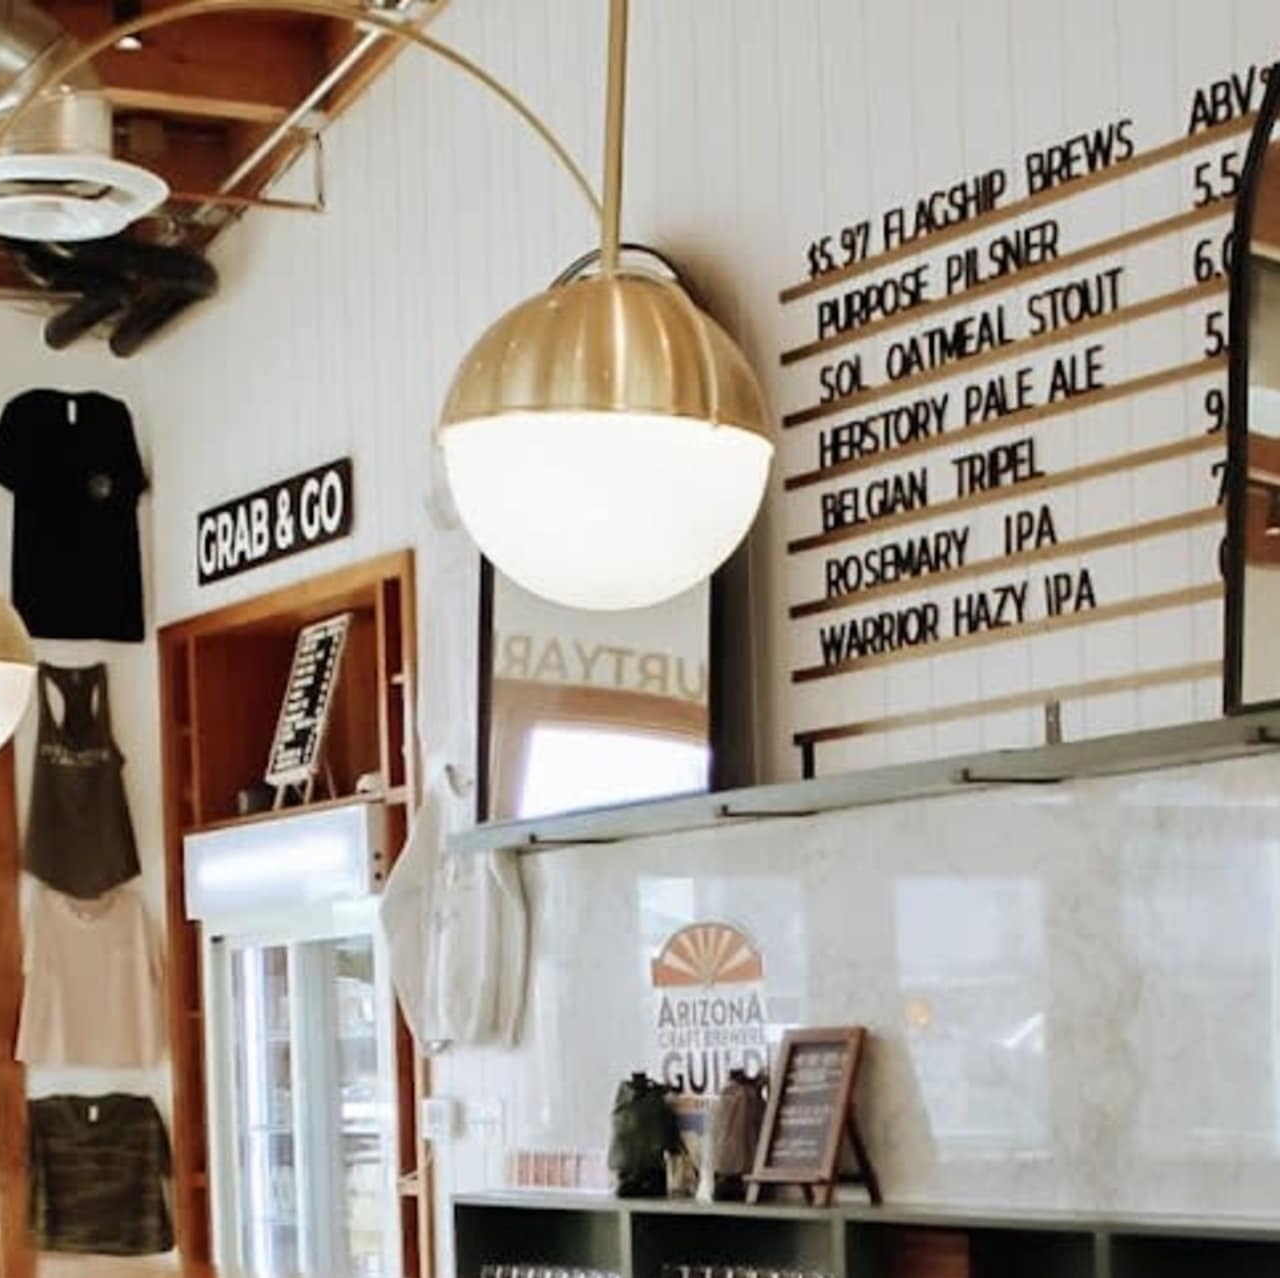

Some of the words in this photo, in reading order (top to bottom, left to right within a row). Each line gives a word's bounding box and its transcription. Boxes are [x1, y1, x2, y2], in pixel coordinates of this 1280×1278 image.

[883, 170, 1006, 251] FLAGSHIP
[1026, 120, 1134, 196] BREWS
[819, 265, 928, 340] PURPOSE
[946, 220, 1058, 295] PILSNER
[821, 355, 867, 402] SOL
[887, 305, 1012, 381] OATMEAL
[1028, 268, 1123, 336] STOUT
[821, 394, 949, 468] HERSTORY
[965, 368, 1033, 424] PALE
[1048, 345, 1105, 392] ALE
[198, 497, 269, 576] GRAB
[274, 488, 294, 549] &
[300, 470, 343, 541] GO
[822, 468, 928, 533] BELGIAN
[952, 437, 1045, 498] TRIPEL
[826, 527, 969, 599] ROSEMARY
[1005, 505, 1057, 556] IPA
[821, 602, 939, 665] WARRIOR
[954, 580, 1027, 639] HAZY
[1046, 568, 1097, 616] IPA
[658, 991, 764, 1028] ARIZONA
